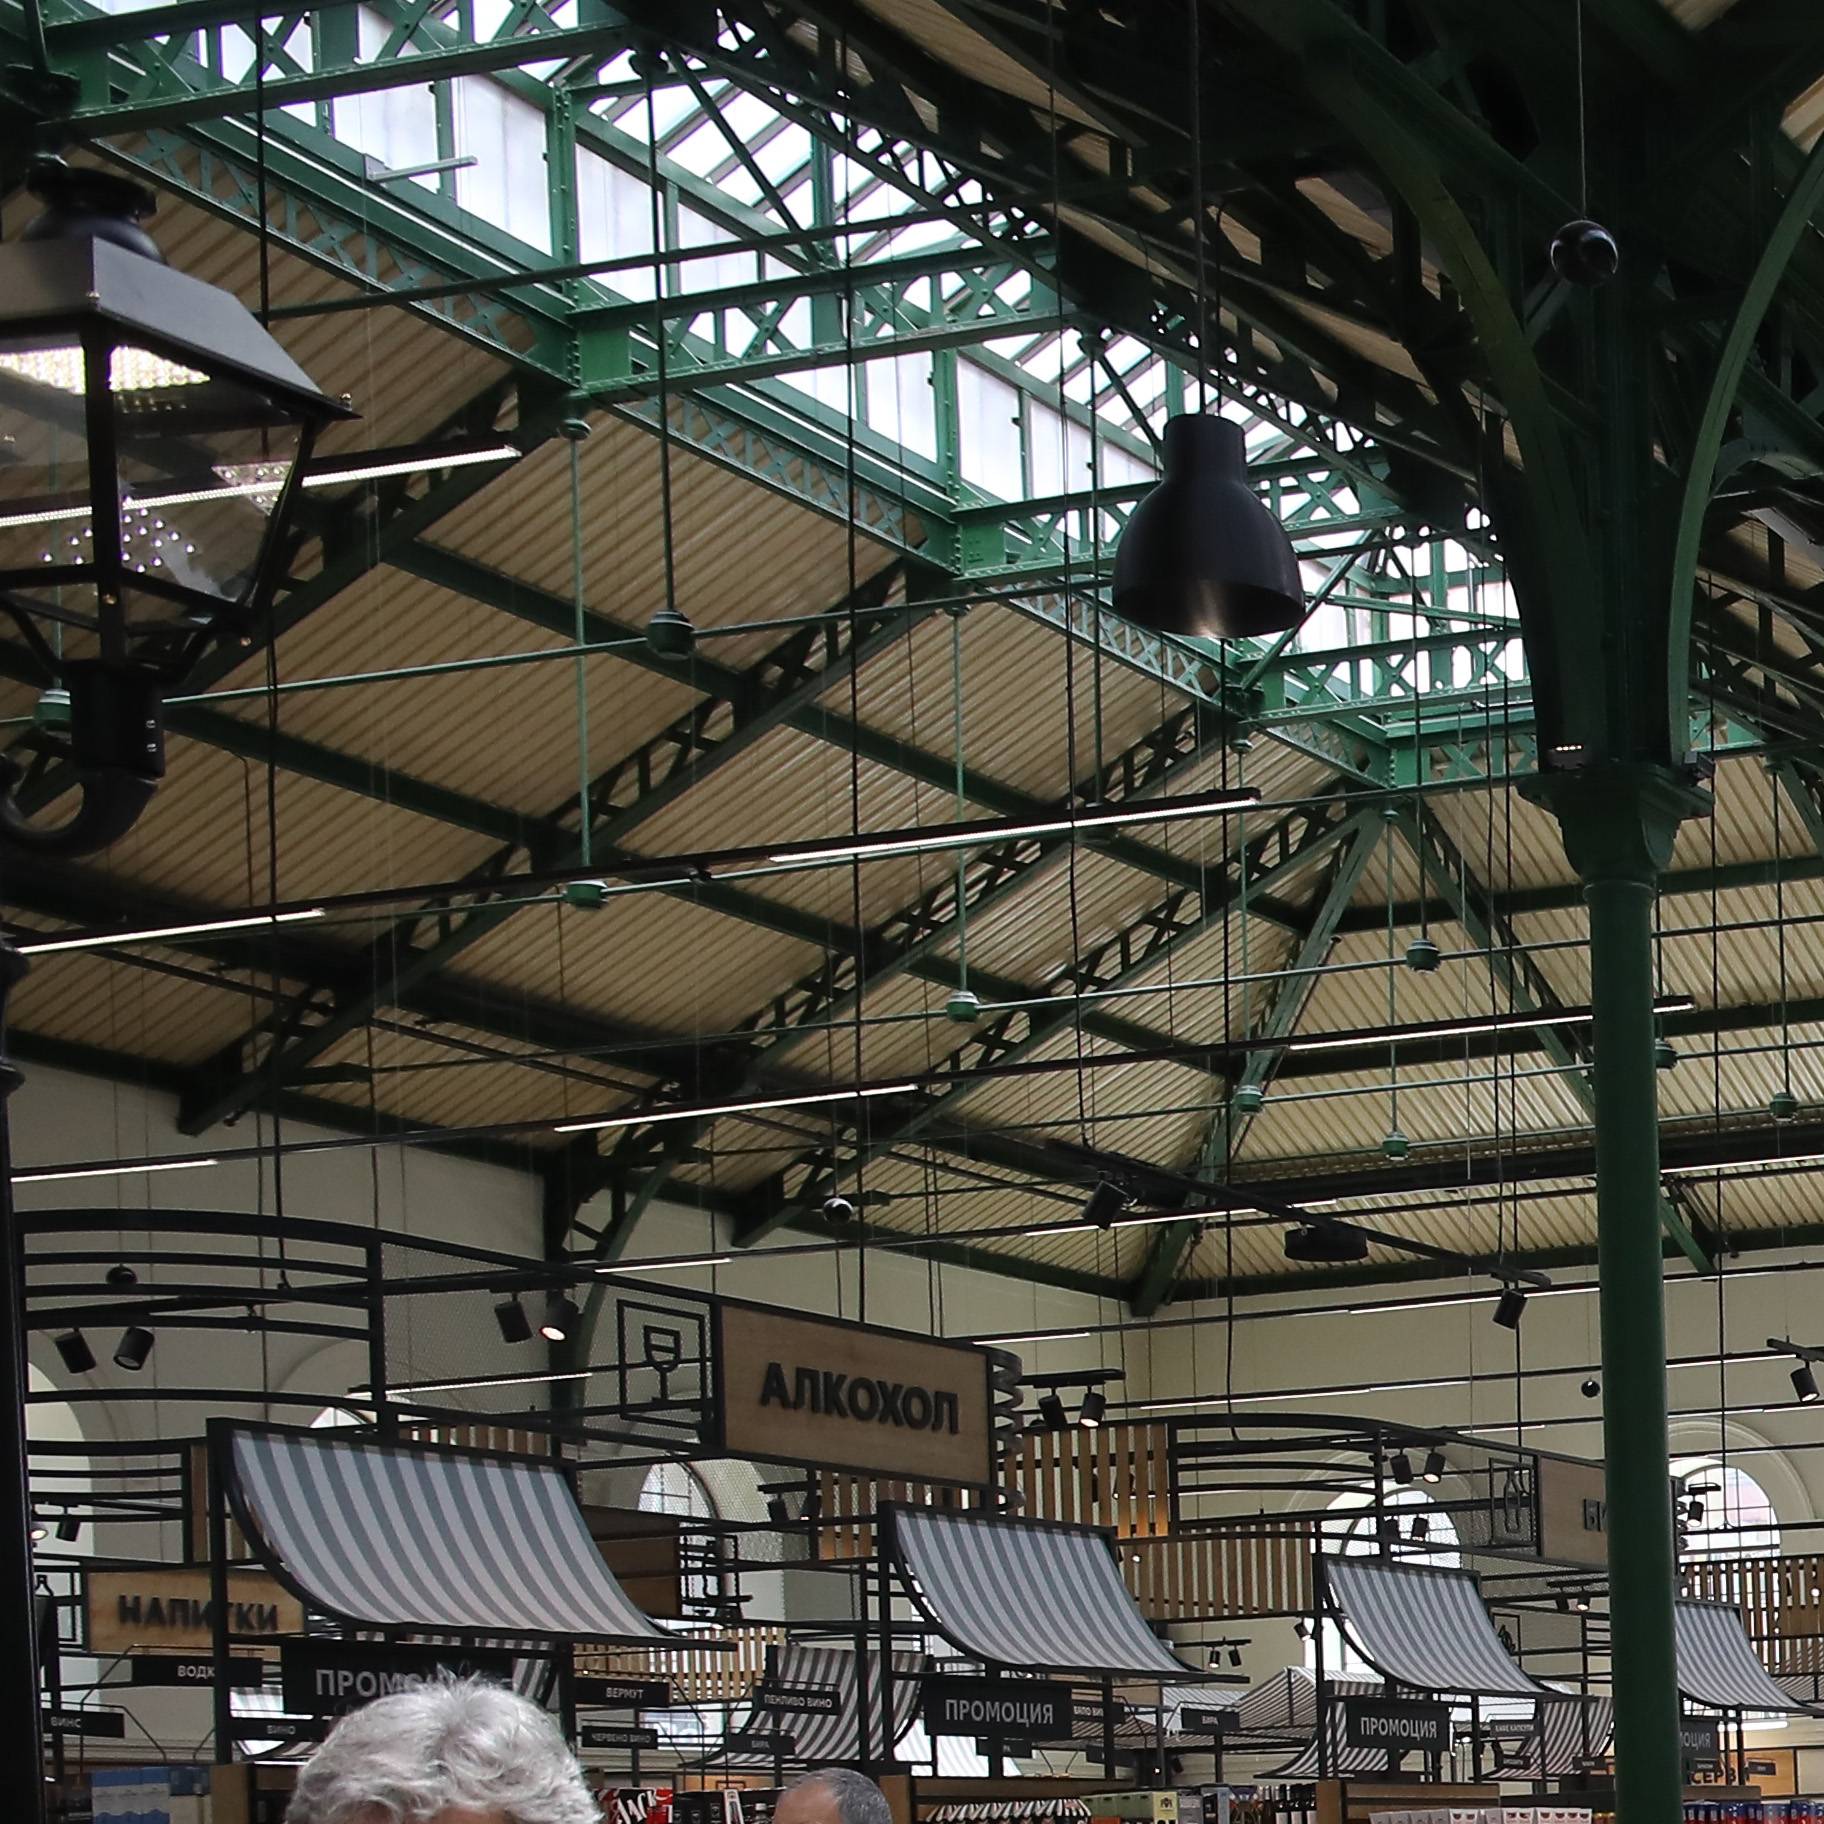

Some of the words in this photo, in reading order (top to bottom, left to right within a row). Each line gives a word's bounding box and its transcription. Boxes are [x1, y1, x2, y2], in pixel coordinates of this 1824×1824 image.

[759, 1361, 961, 1436] АЛКОХОЛ
[117, 1594, 279, 1633] НАПИКИ
[177, 1664, 215, 1678] ВОДК
[606, 1686, 644, 1700] ВЕРМУТ
[806, 1696, 833, 1709] ВИНО
[945, 1699, 1053, 1727] ПРОМОЦИЯ
[1092, 1706, 1104, 1717] ВИ
[1360, 1716, 1438, 1741] ПРОМОЦИЯ
[591, 1732, 628, 1743] ЧЕРВЕНО
[629, 1734, 652, 1744] ВИНО
[1690, 1766, 1750, 1785] СЕРВ
